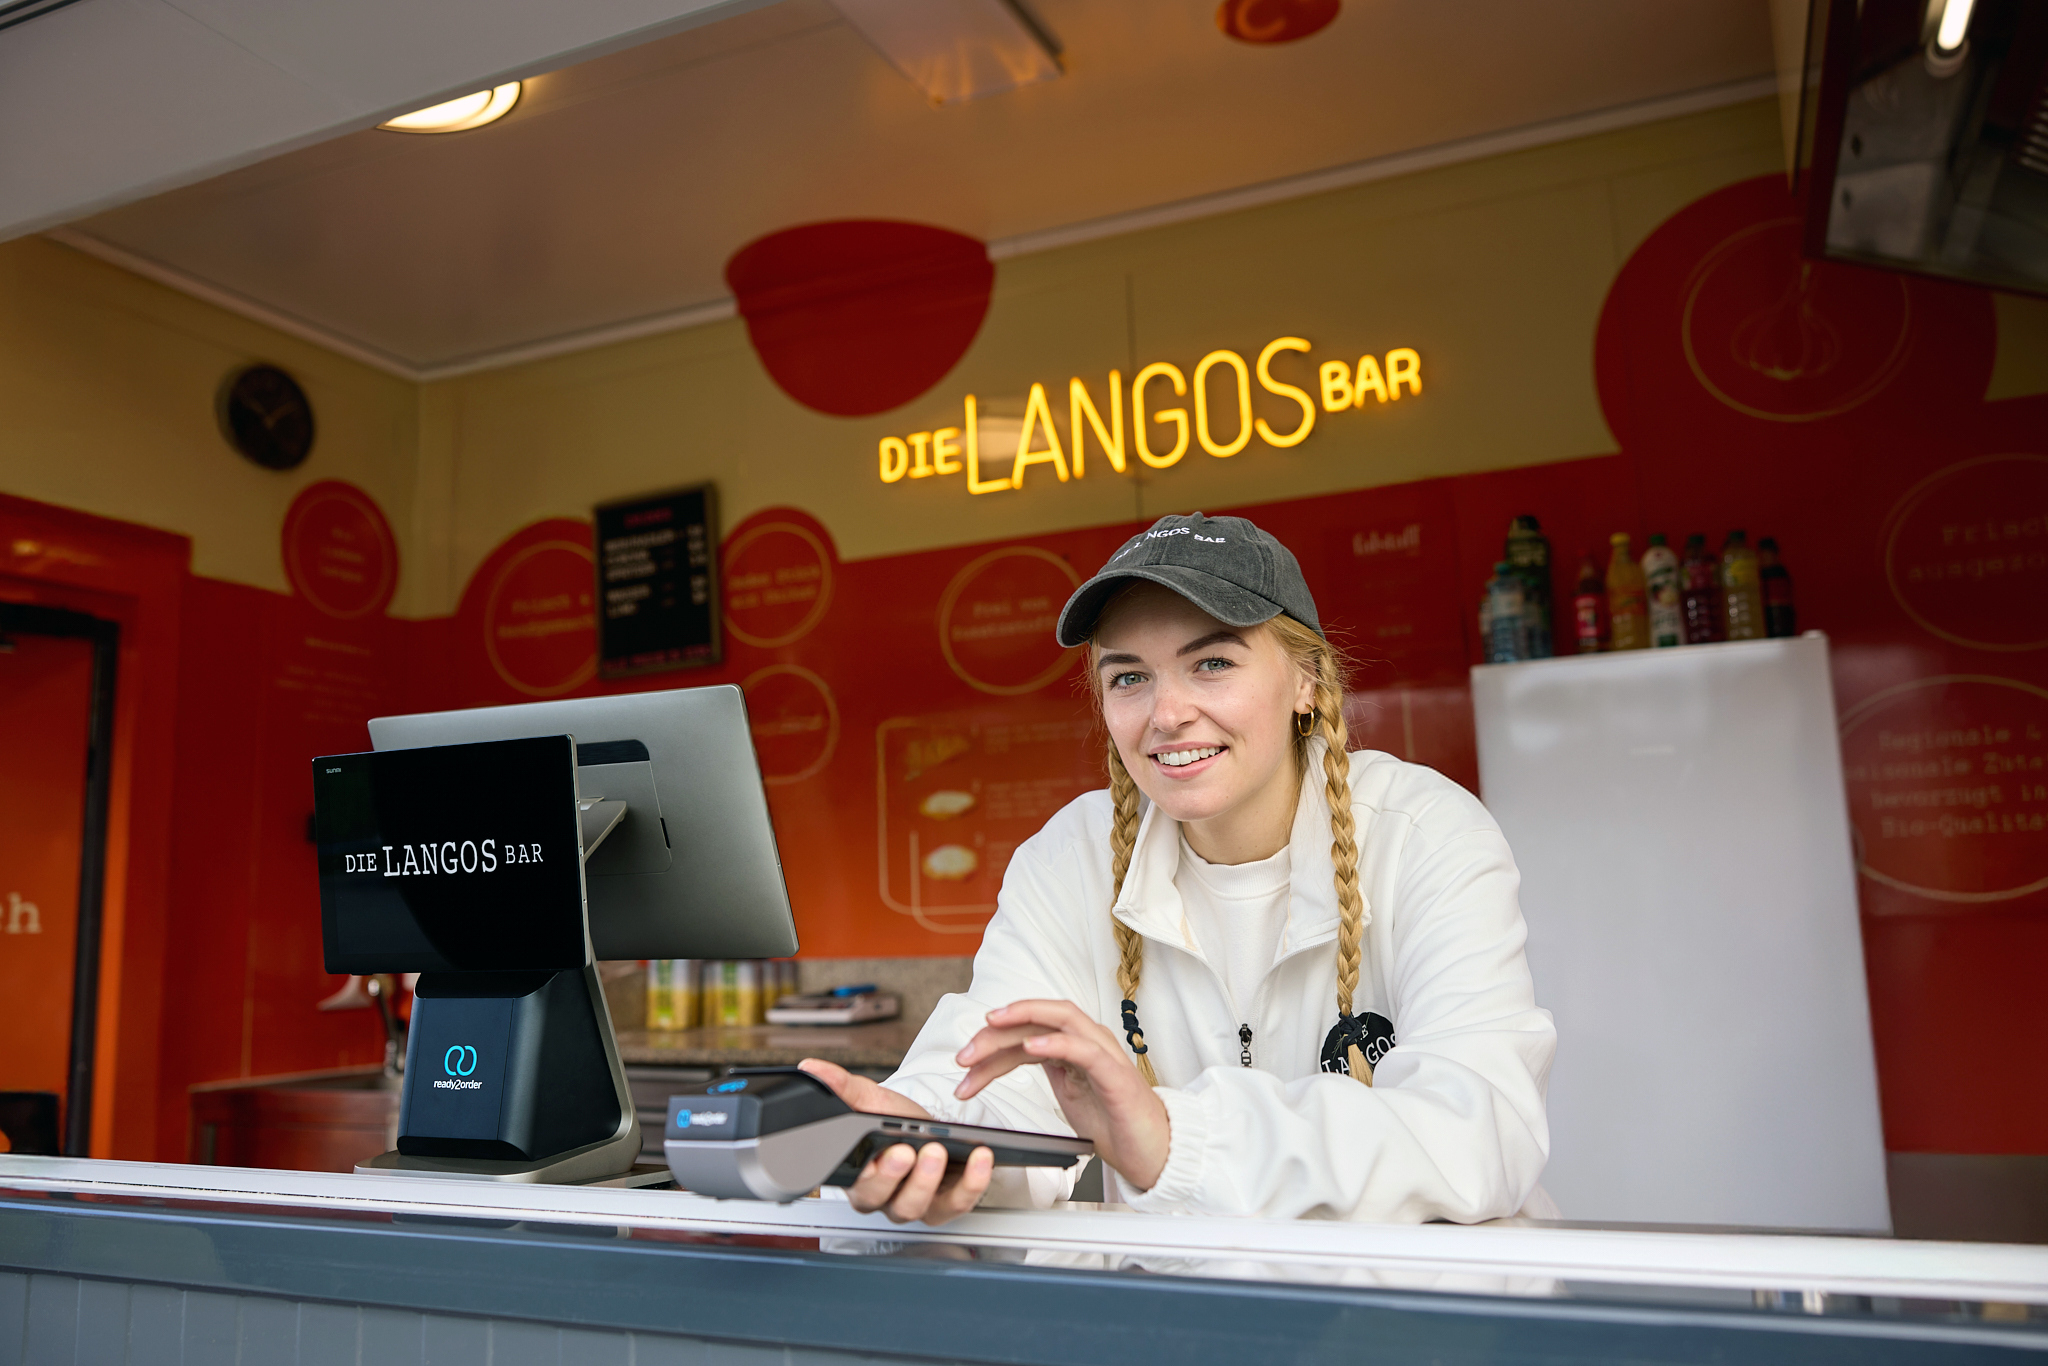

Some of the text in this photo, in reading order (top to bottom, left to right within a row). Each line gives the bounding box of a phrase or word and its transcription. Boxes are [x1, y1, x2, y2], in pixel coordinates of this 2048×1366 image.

[878, 336, 1422, 495] DIE LANGOS BAR
[345, 839, 544, 877] DIE LANGOS BAR
[433, 1079, 483, 1090] ready2order
